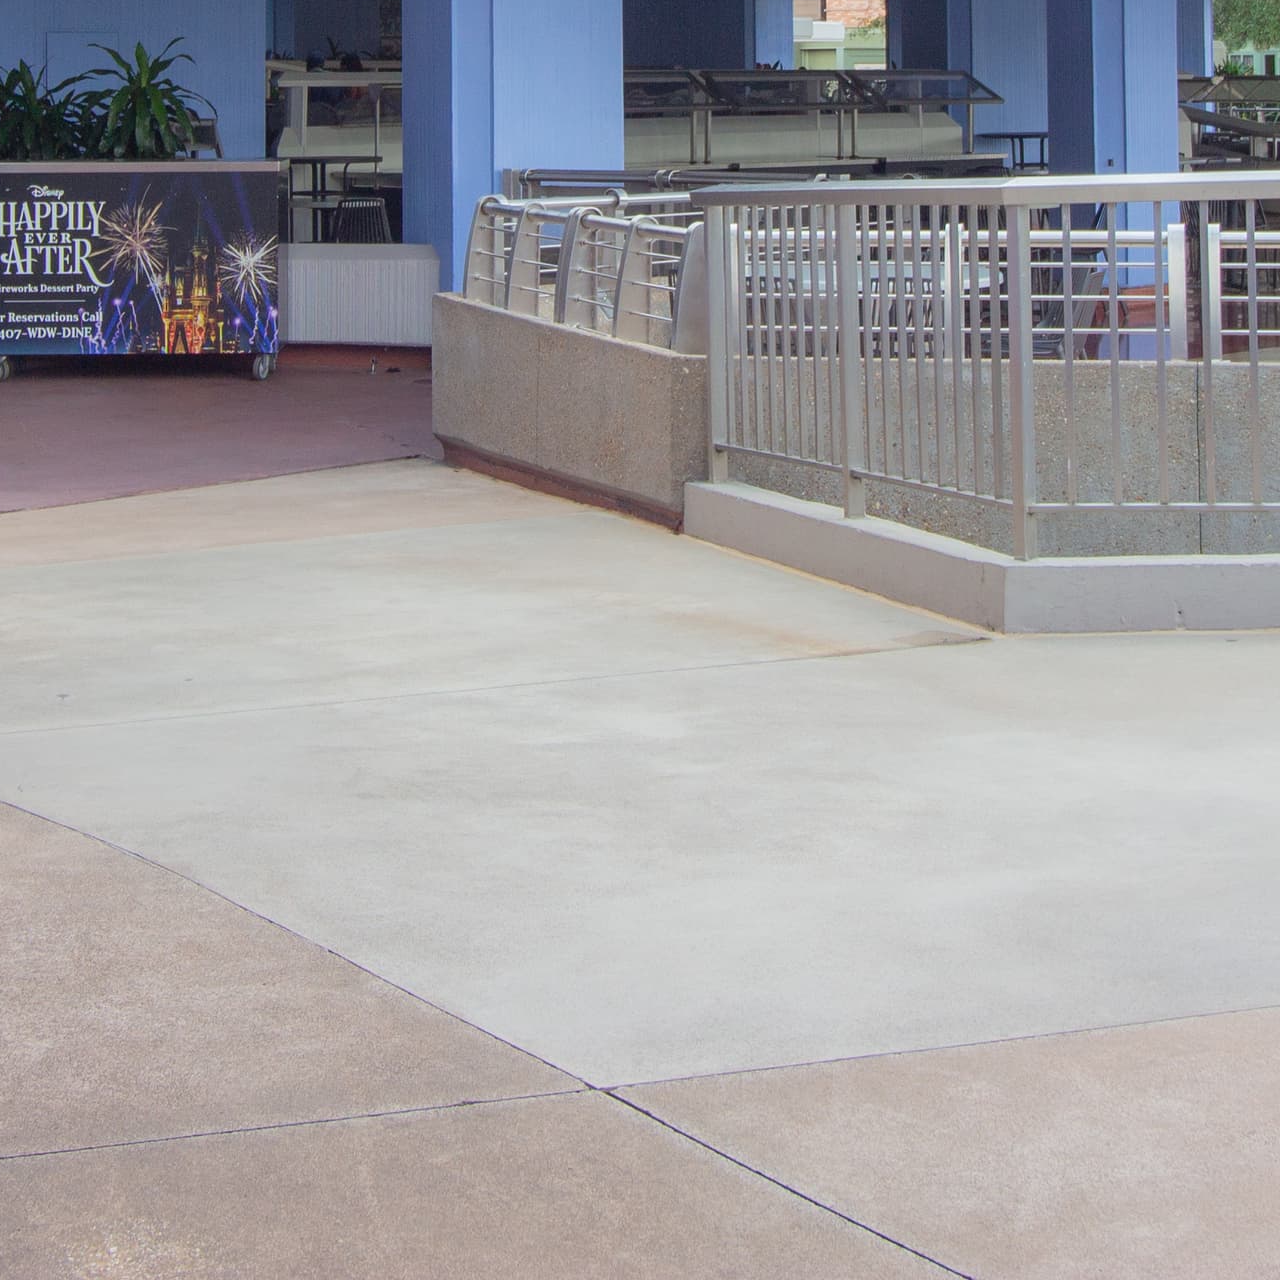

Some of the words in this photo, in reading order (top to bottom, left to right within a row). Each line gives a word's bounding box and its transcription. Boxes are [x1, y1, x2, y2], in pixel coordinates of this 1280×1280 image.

[27, 185, 65, 200] Disney
[24, 232, 71, 244] EVER
[0, 238, 115, 287] AFTER
[40, 284, 74, 293] Dessert
[76, 284, 100, 295] Party
[8, 311, 79, 323] Reservations
[82, 311, 103, 322] Call
